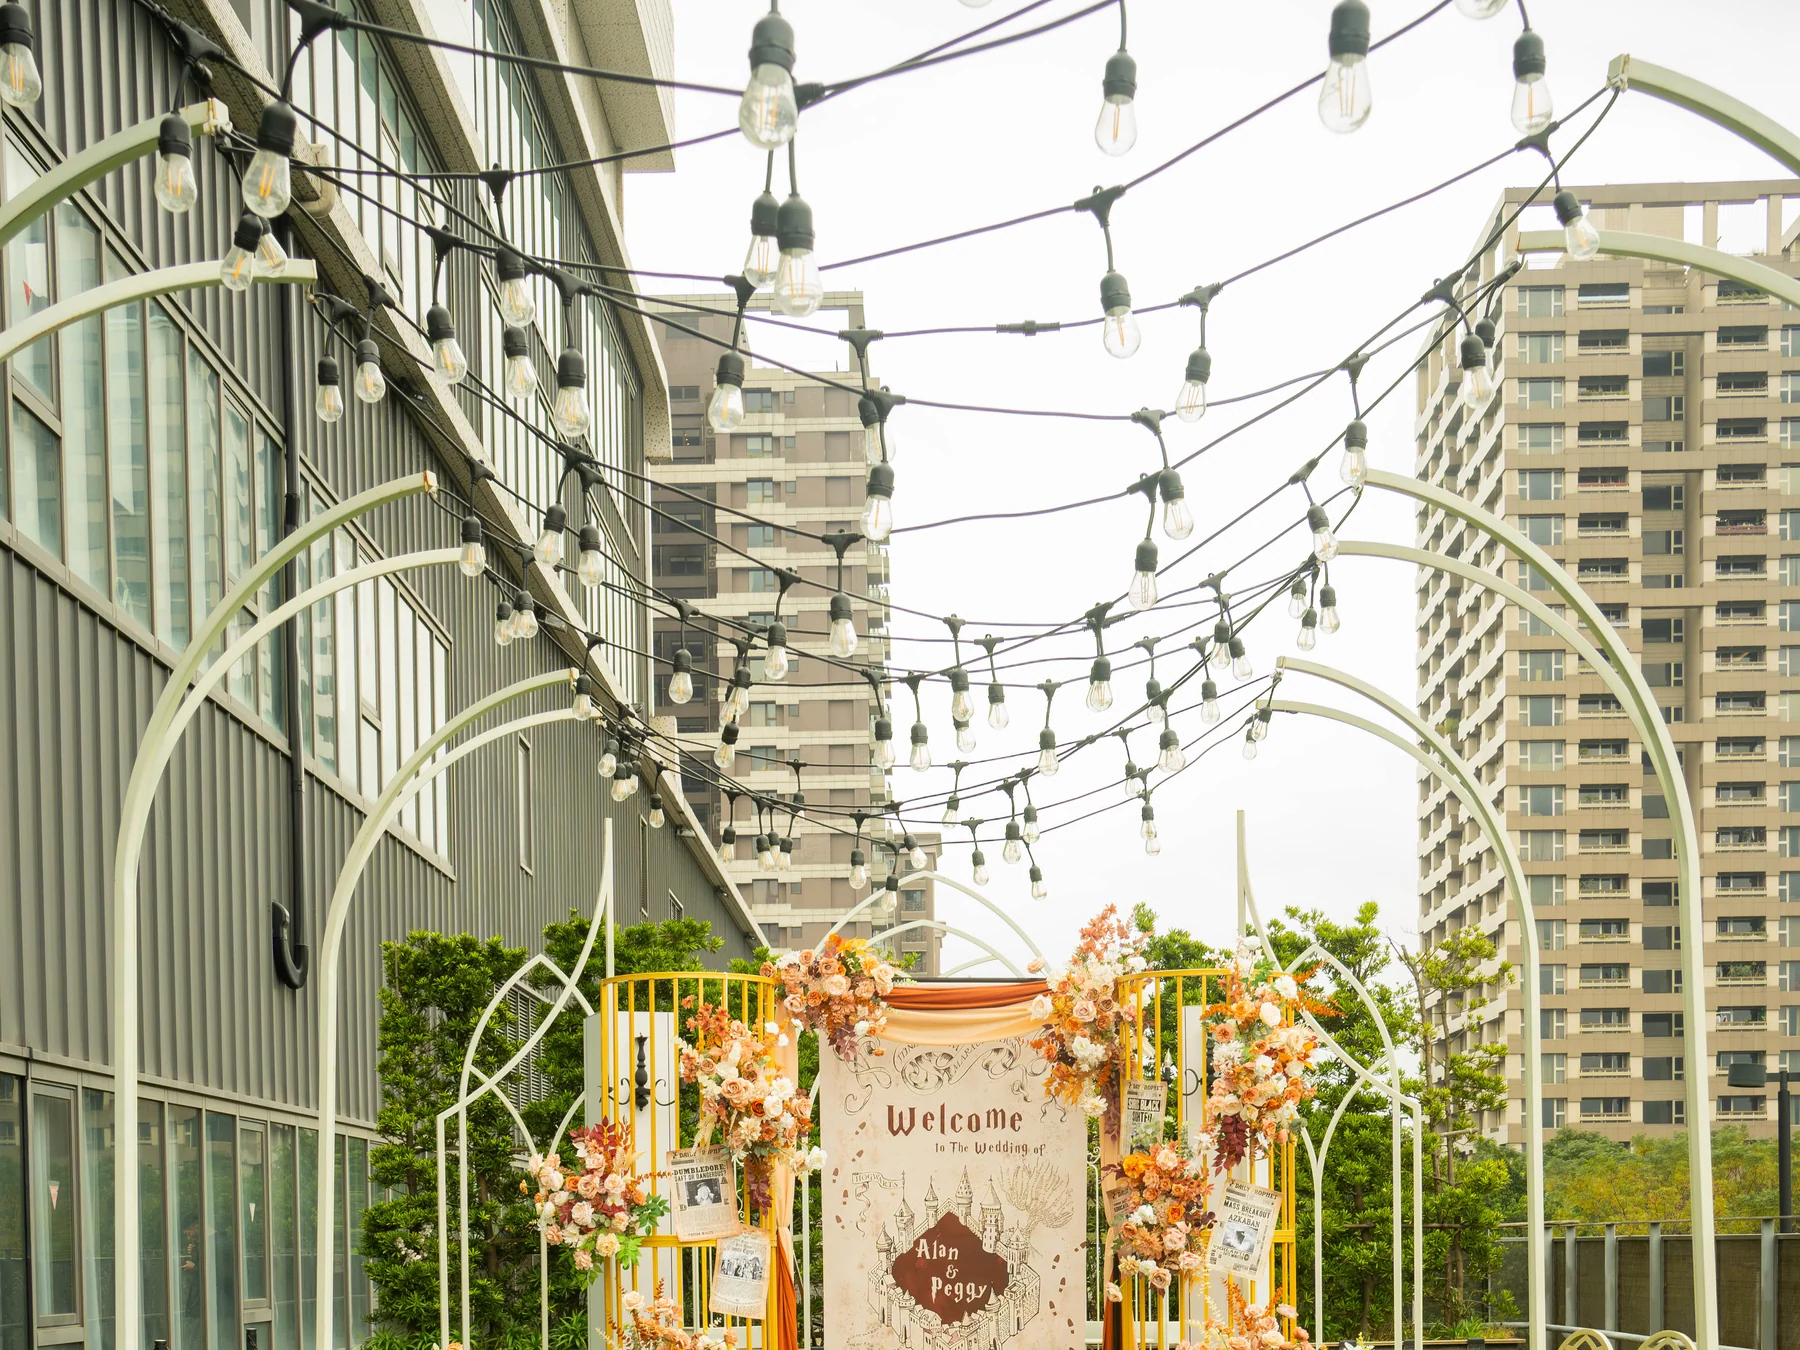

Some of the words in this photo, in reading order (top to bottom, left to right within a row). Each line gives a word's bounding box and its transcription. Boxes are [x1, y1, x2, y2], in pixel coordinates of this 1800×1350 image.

[886, 1102, 1024, 1137] Welcome
[935, 1142, 945, 1153] to
[950, 1141, 969, 1154] The
[975, 1139, 1028, 1157] Wedding
[1033, 1143, 1046, 1157] of
[855, 1173, 900, 1188] HOGWARTS
[1223, 1199, 1241, 1211] MASS
[1241, 1204, 1272, 1219] BREAKOUT
[1228, 1213, 1261, 1228] AZKABAN
[915, 1238, 959, 1260] Alan
[945, 1264, 959, 1279] &
[931, 1276, 988, 1304] Peggy
